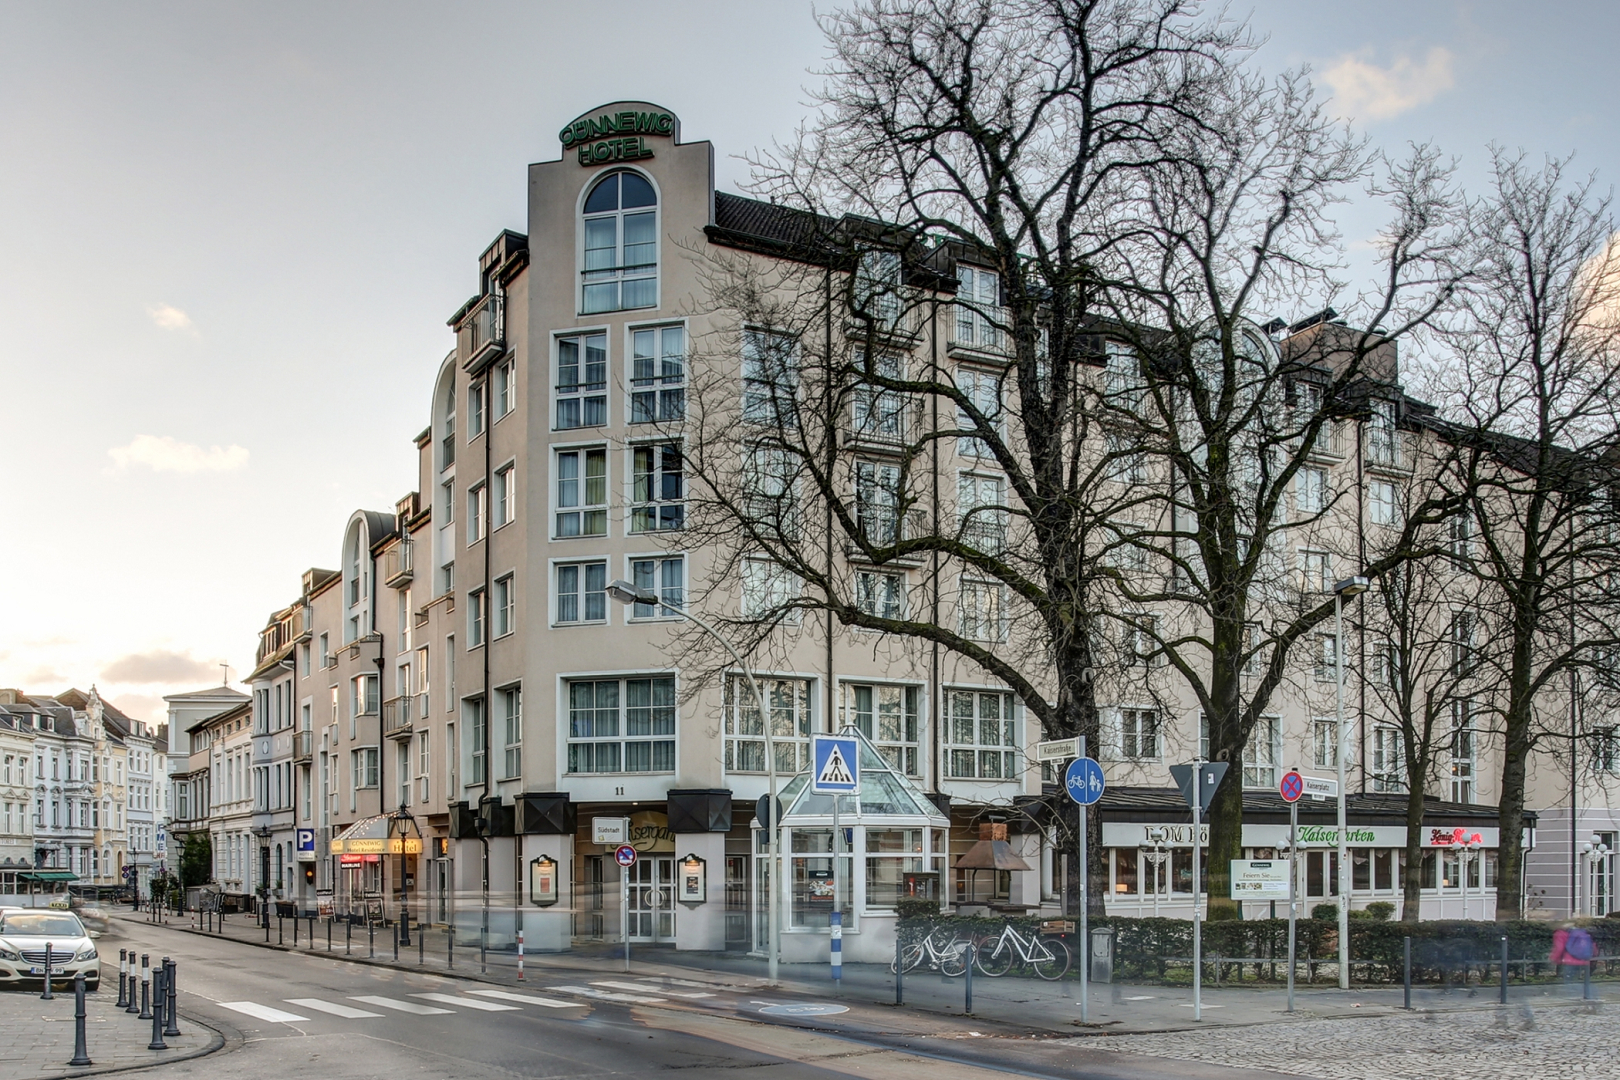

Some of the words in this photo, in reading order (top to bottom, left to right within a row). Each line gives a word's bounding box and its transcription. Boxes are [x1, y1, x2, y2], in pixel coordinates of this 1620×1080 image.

[578, 136, 654, 165] HOTEL
[1043, 744, 1072, 754] Kaiserstraße
[1306, 781, 1330, 791] Kaiserplatz
[615, 787, 625, 796] 11
[598, 826, 620, 834] Südstadt
[298, 831, 313, 849] P
[393, 844, 417, 852] Htel
